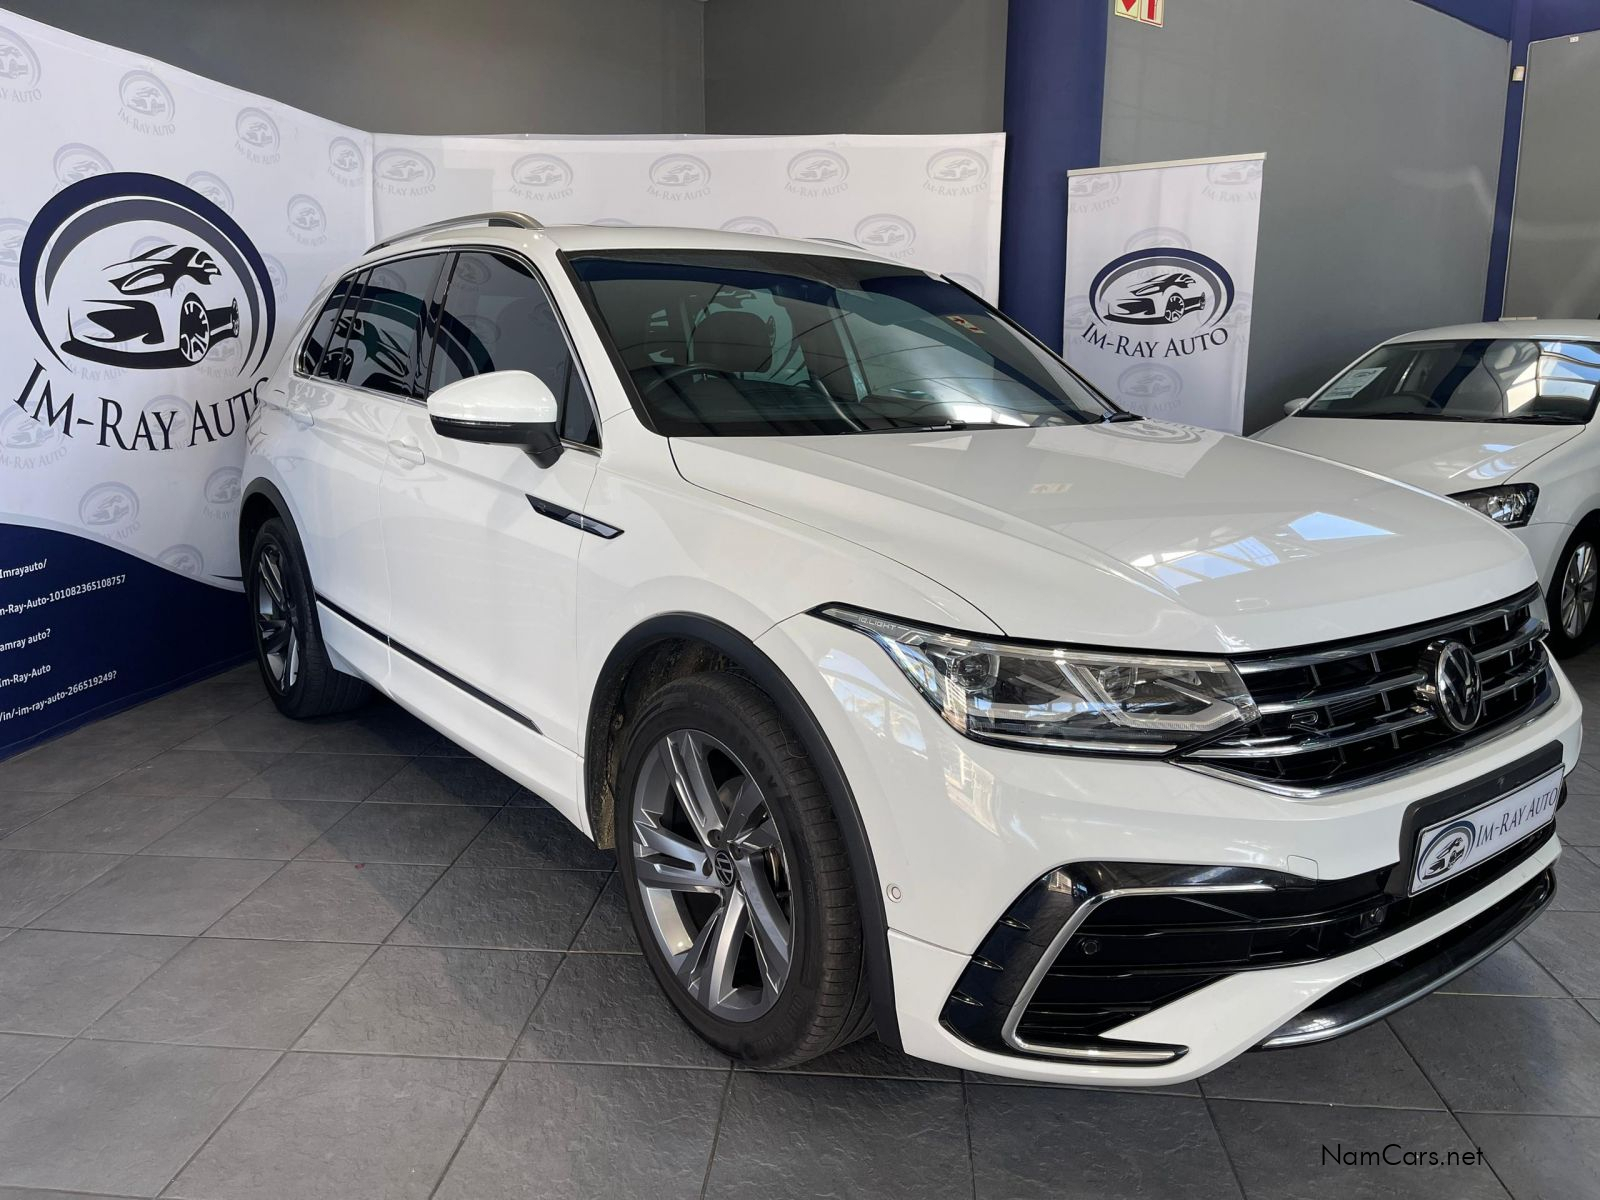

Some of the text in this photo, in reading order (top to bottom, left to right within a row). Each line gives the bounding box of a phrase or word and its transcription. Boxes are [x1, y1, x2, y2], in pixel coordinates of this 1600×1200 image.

[1081, 322, 1229, 358] IM-RAY AUTO
[13, 358, 178, 451] IM-RAY
[27, 627, 51, 645] auto?
[1476, 787, 1558, 848] IM-RAY AUTO
